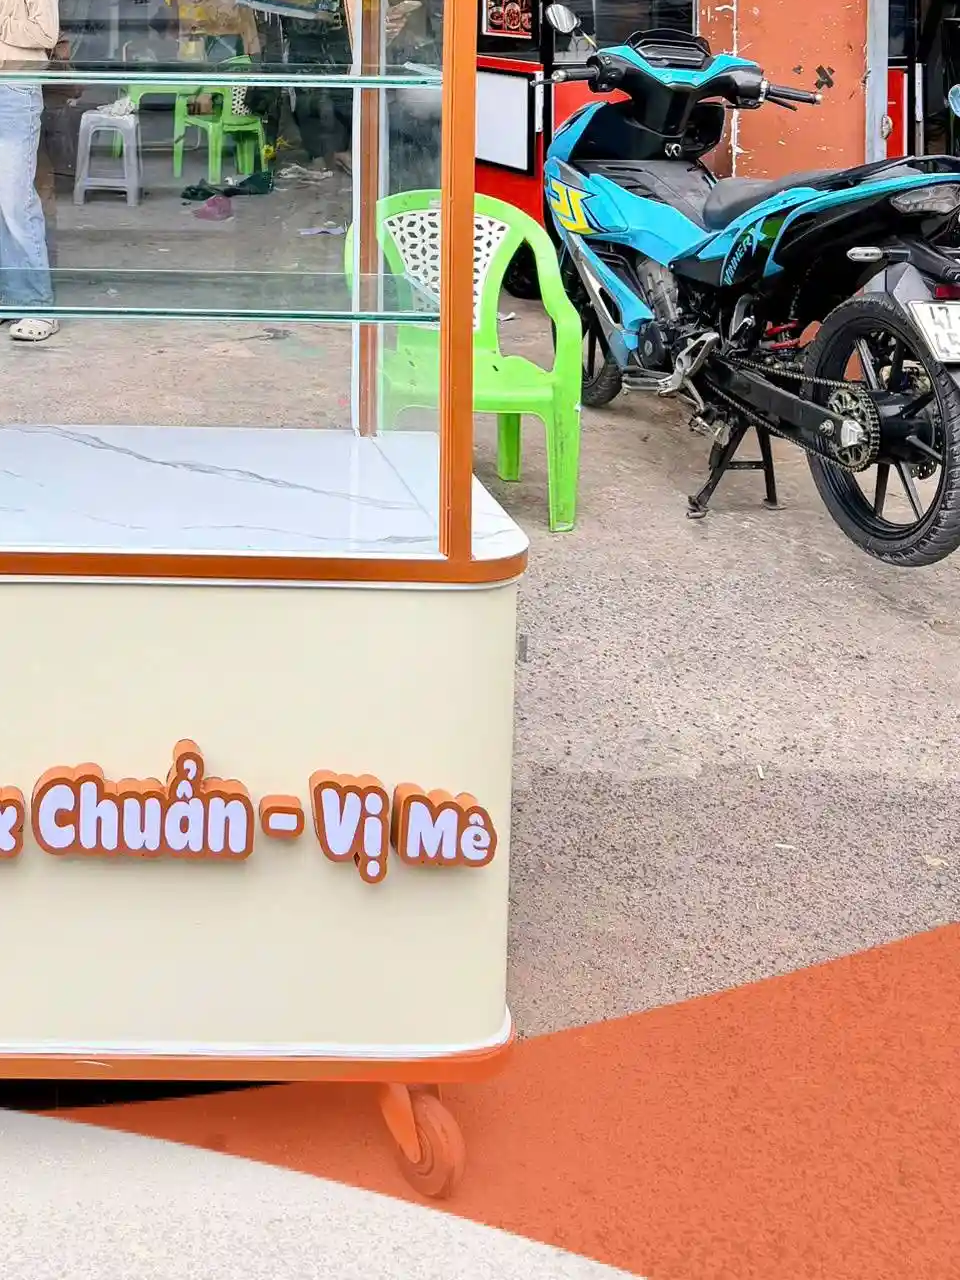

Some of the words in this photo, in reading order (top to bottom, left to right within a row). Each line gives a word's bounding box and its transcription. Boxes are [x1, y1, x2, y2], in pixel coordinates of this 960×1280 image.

[36, 755, 251, 856] Chuẩn
[317, 784, 387, 882] Vị
[402, 799, 494, 863] Mê
